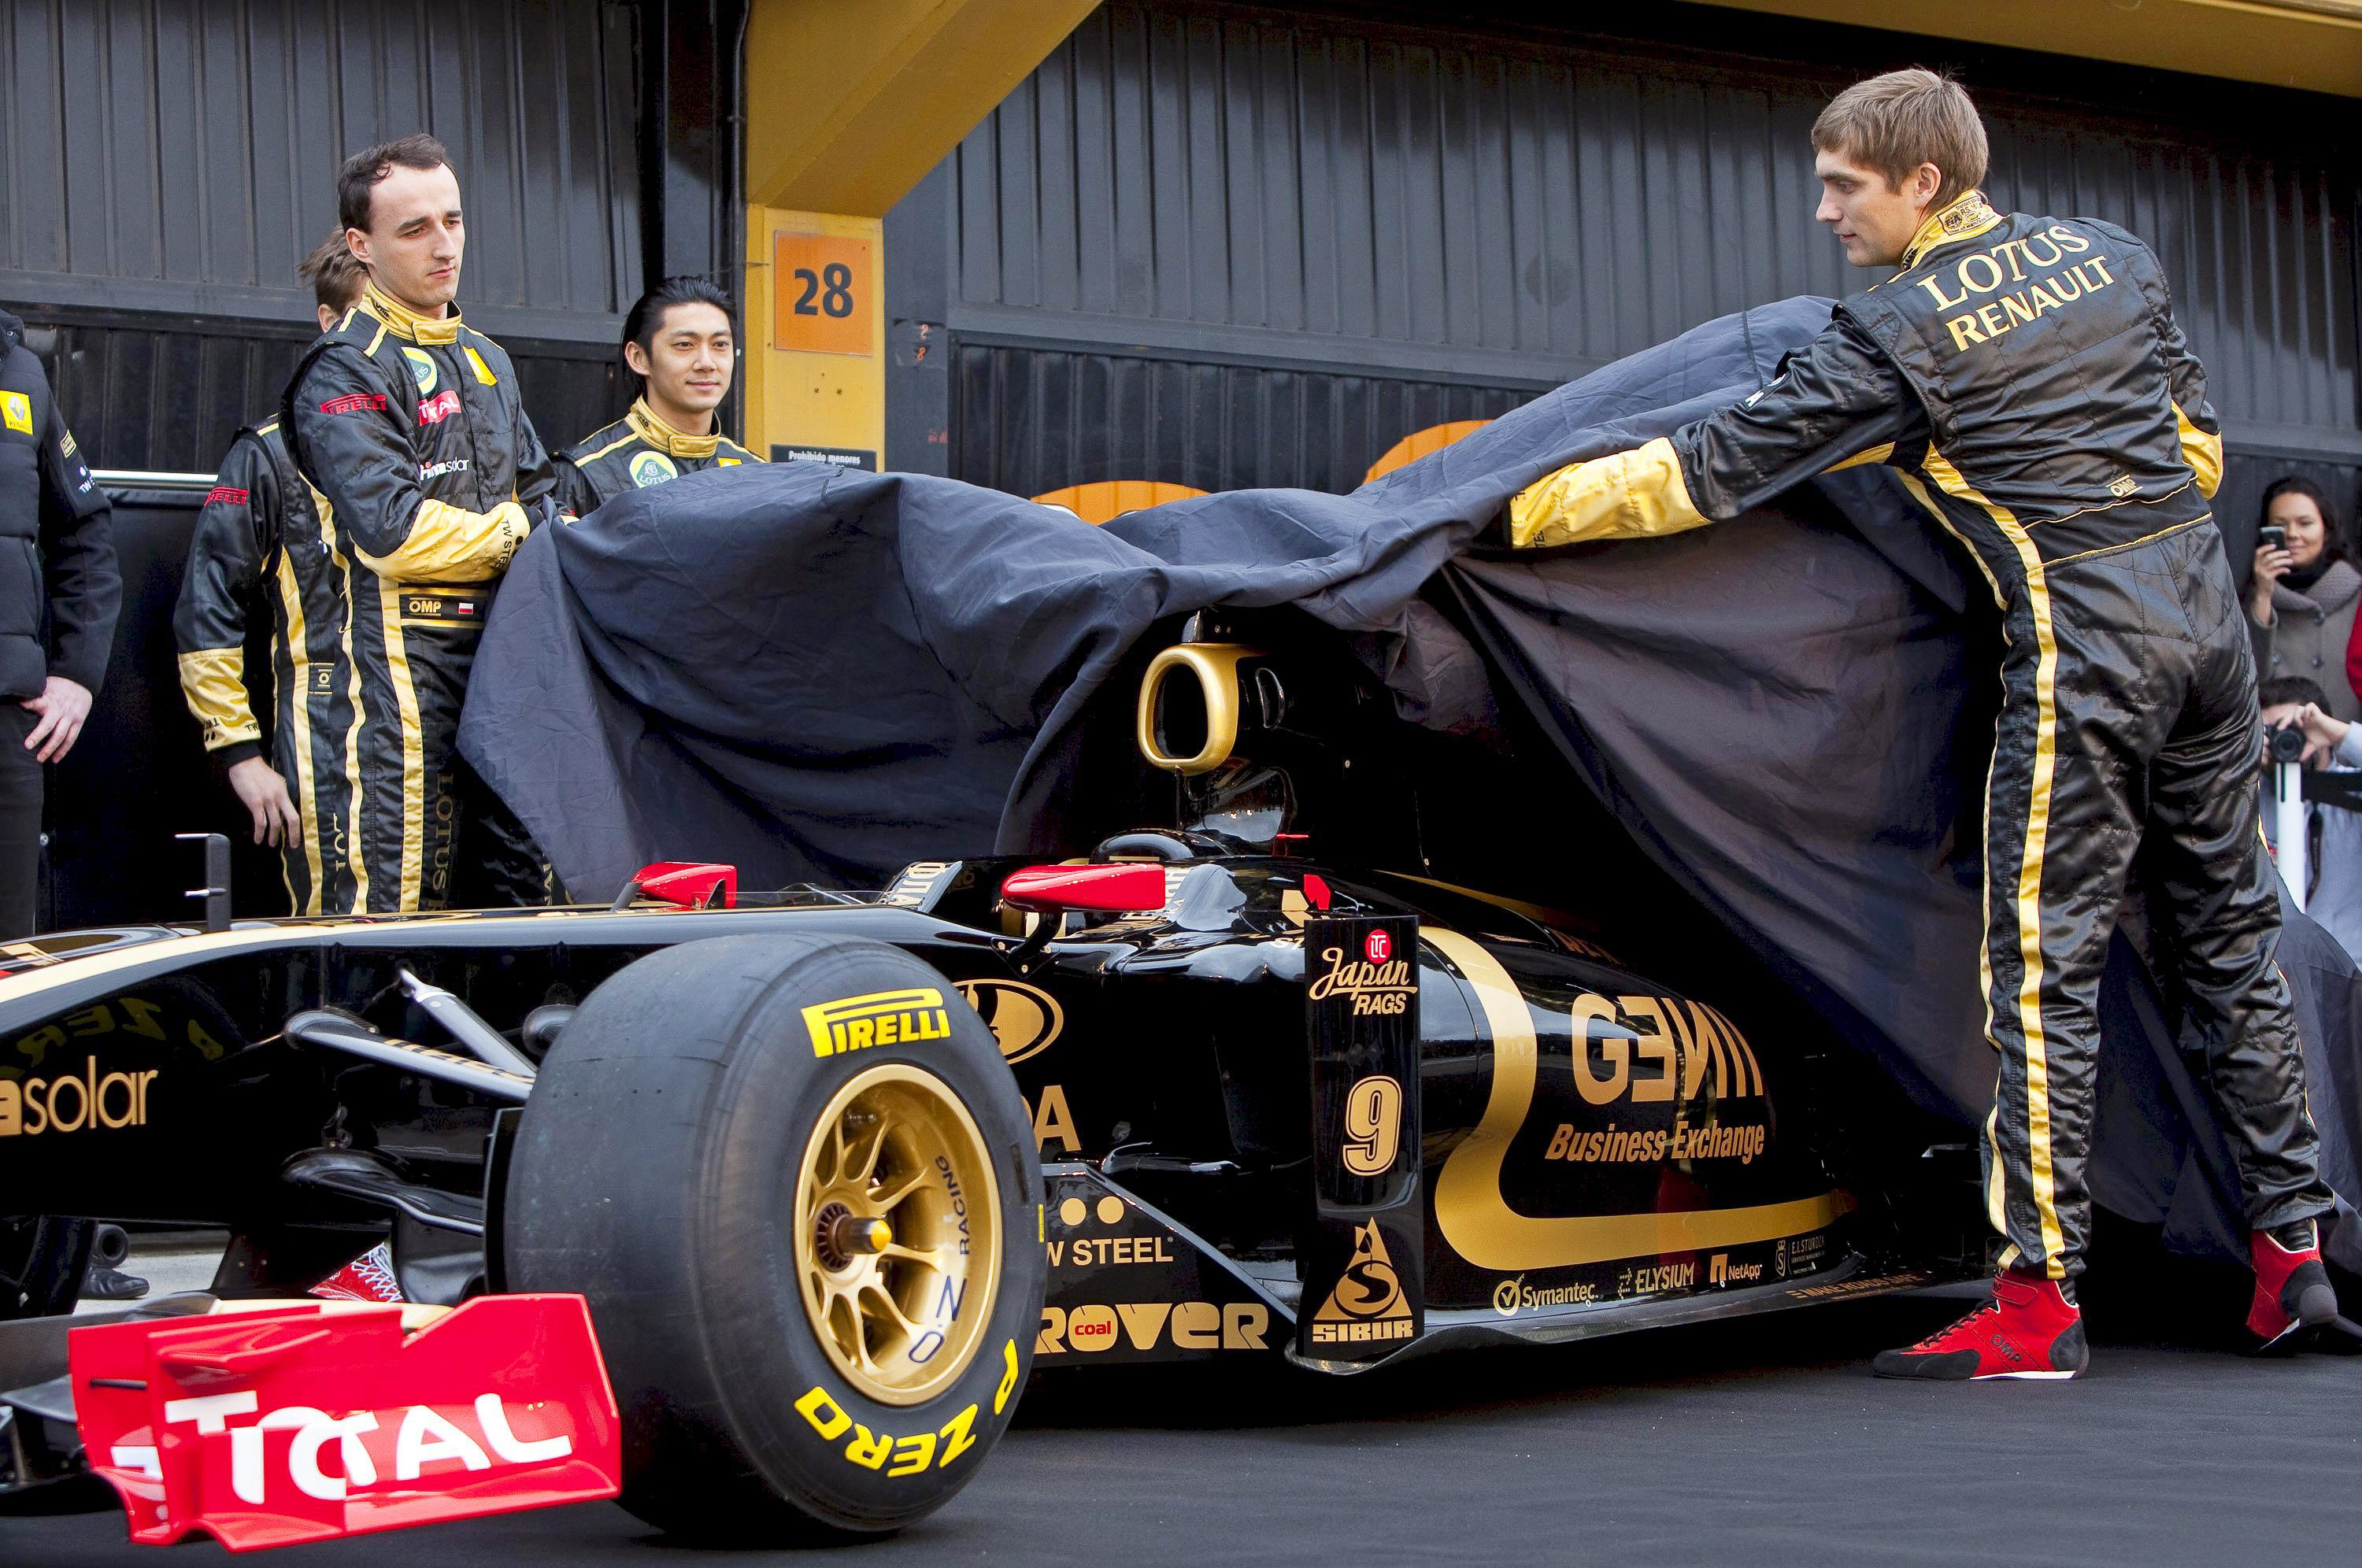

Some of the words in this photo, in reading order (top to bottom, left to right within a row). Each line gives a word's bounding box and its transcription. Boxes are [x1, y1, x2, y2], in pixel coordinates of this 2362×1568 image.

[1916, 225, 2090, 312] LOTUS
[794, 262, 854, 318] 28
[1946, 255, 2115, 352] RENAULT
[788, 450, 827, 463] Prohibido
[827, 454, 861, 465] menores
[639, 473, 672, 485] LOTUS
[2110, 479, 2137, 497] OMP
[409, 600, 442, 614] OMP
[435, 773, 454, 891] LOTUS
[1309, 947, 1418, 1000] Japan
[800, 988, 951, 1059] PIRELLI
[1353, 993, 1407, 1015] RAGS
[1342, 1075, 1402, 1176] 9
[1545, 1123, 1668, 1163] Business
[1671, 1119, 1764, 1165] Exchange
[935, 1155, 971, 1256] RACING
[1072, 1237, 1174, 1266] STEEL
[1635, 1262, 1695, 1294] ELYSIUM
[1728, 1263, 1760, 1281] NetApp
[1075, 1320, 1112, 1336] coal
[1312, 1319, 1414, 1343] SIBUR
[1990, 1334, 2023, 1363] OMP
[163, 1390, 573, 1507] TOTAL
[794, 1385, 979, 1479] ZERO
